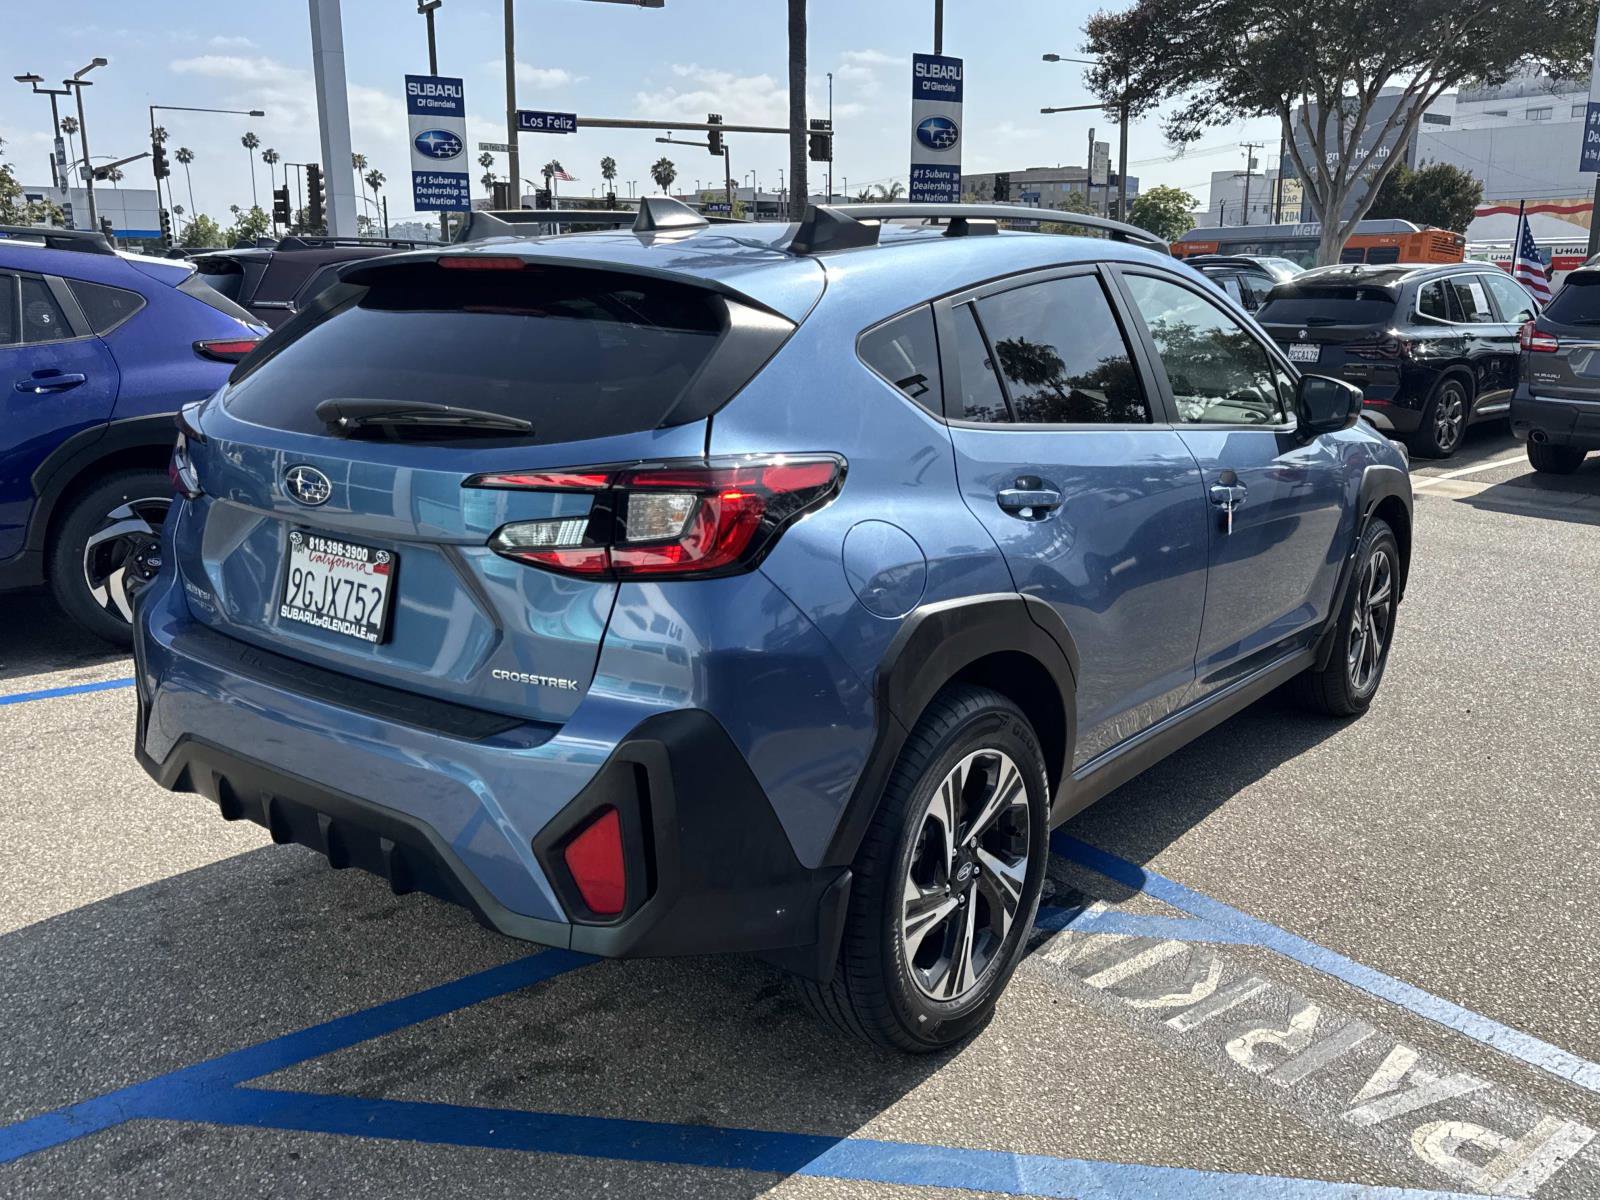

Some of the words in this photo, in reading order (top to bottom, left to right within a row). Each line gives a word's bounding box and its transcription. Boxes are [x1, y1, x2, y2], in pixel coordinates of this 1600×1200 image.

[916, 63, 961, 80] SUBARU
[408, 83, 462, 98] SUBARU
[922, 81, 930, 90] Of
[931, 82, 956, 92] Glendale
[417, 99, 426, 107] Of
[427, 100, 456, 109] Glendale
[522, 114, 542, 127] Los
[547, 116, 573, 129] Feliz
[1355, 147, 1390, 159] Helth
[913, 170, 923, 178] #1
[925, 170, 950, 179] Subaru
[416, 176, 427, 184] #1
[428, 176, 457, 185] Subaru
[416, 187, 459, 197] Dealership
[913, 182, 951, 192] Dealership
[429, 197, 456, 206] Nation
[924, 193, 948, 202] Nation
[1292, 225, 1320, 236] Metr
[309, 537, 368, 561] 818-396-3900
[308, 550, 372, 576] California
[289, 567, 382, 628] 9GJX752
[492, 669, 578, 691] CROSSTREK
